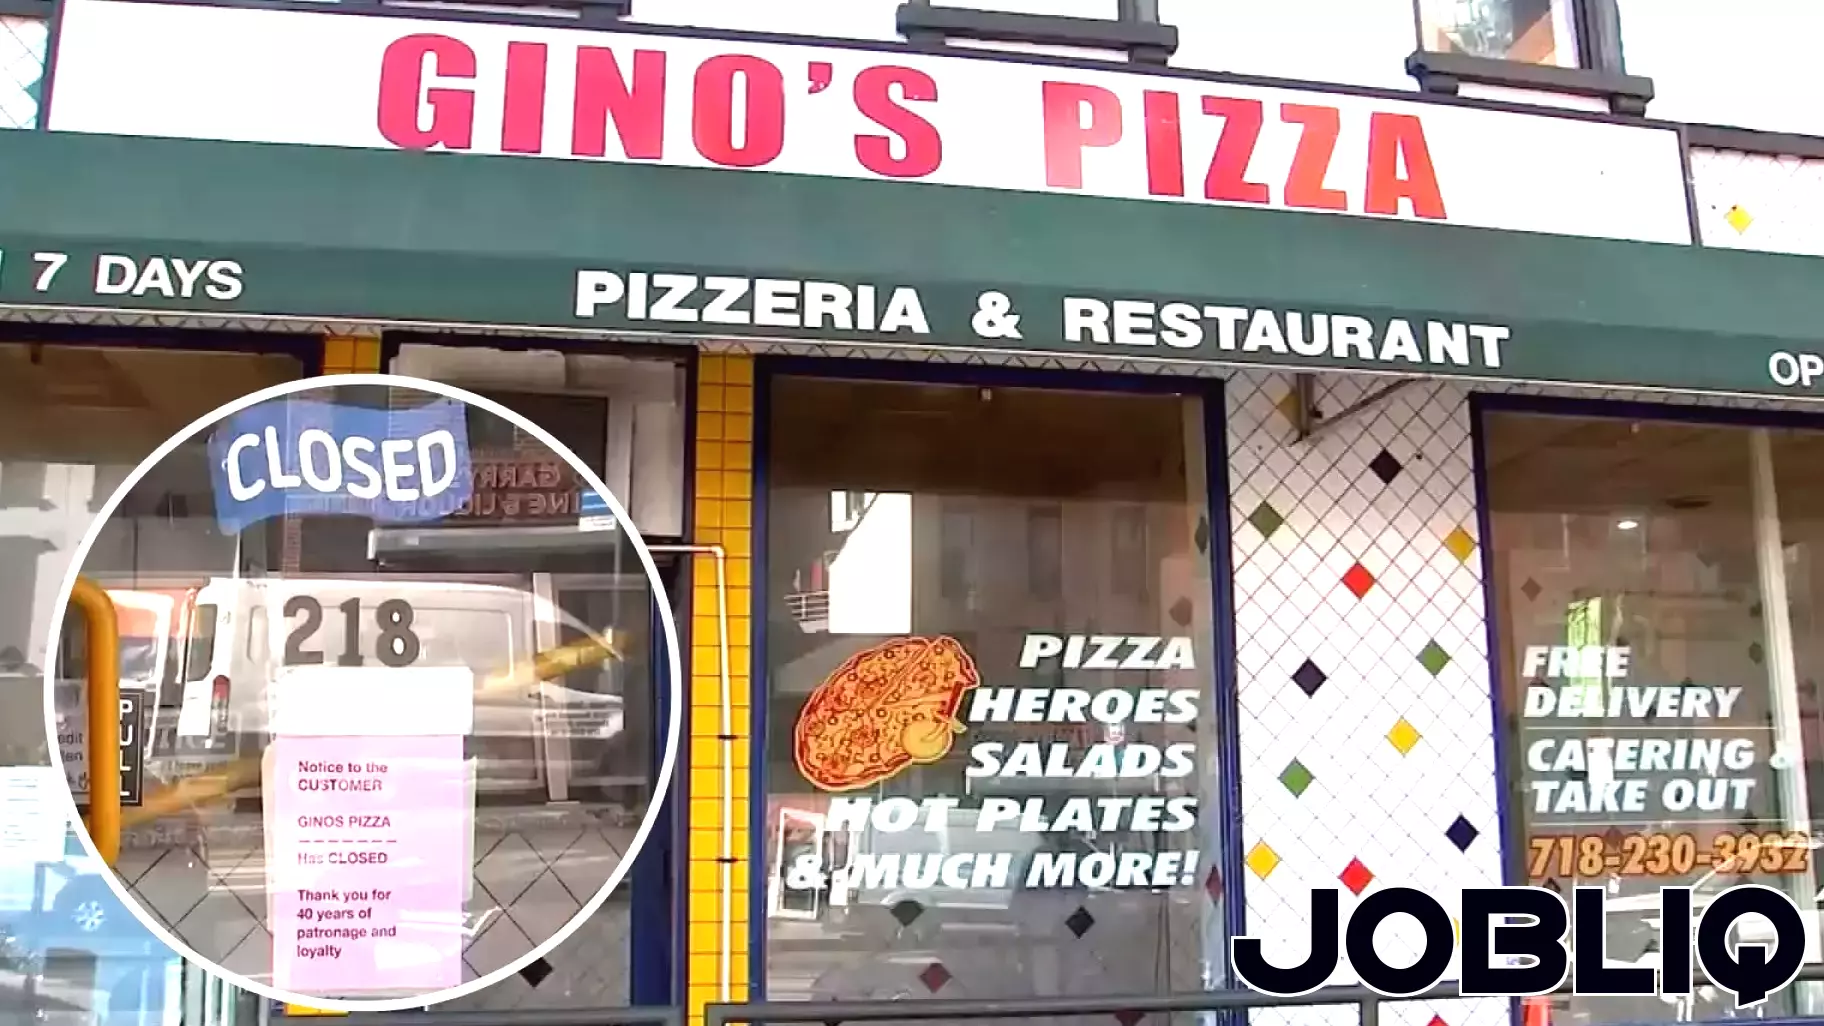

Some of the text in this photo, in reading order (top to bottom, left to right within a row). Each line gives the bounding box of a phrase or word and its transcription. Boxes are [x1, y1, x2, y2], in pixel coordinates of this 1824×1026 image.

[377, 33, 1447, 220] GINO'S PIZZA
[33, 251, 68, 291] 7
[95, 254, 244, 301] DAYS
[574, 269, 1510, 367] PIZZERIA & RESTAURANT
[227, 426, 457, 502] CLOSED
[283, 595, 420, 667] 218
[1020, 635, 1196, 670] PIZZA
[1522, 645, 1632, 678] FREE
[968, 689, 1201, 723] HEROES
[1524, 686, 1743, 718] DELIVERY
[298, 760, 388, 773] Notice to the
[965, 741, 1196, 778] SALADS
[1527, 738, 1755, 772] CATERING
[298, 778, 382, 792] CUSTOMER
[1531, 778, 1757, 813] TAKE OUT
[298, 815, 390, 829] GINOS PIZZA
[823, 797, 1198, 832] HOT PLATES
[298, 851, 388, 865] Has CLOSED
[786, 850, 1201, 889] & MUCH MORE!
[1527, 831, 1812, 878] 718-230-3932
[298, 888, 391, 903] Thank you for
[297, 906, 372, 922] 40 years of
[297, 925, 396, 941] patronage and
[297, 944, 342, 959] loyalty
